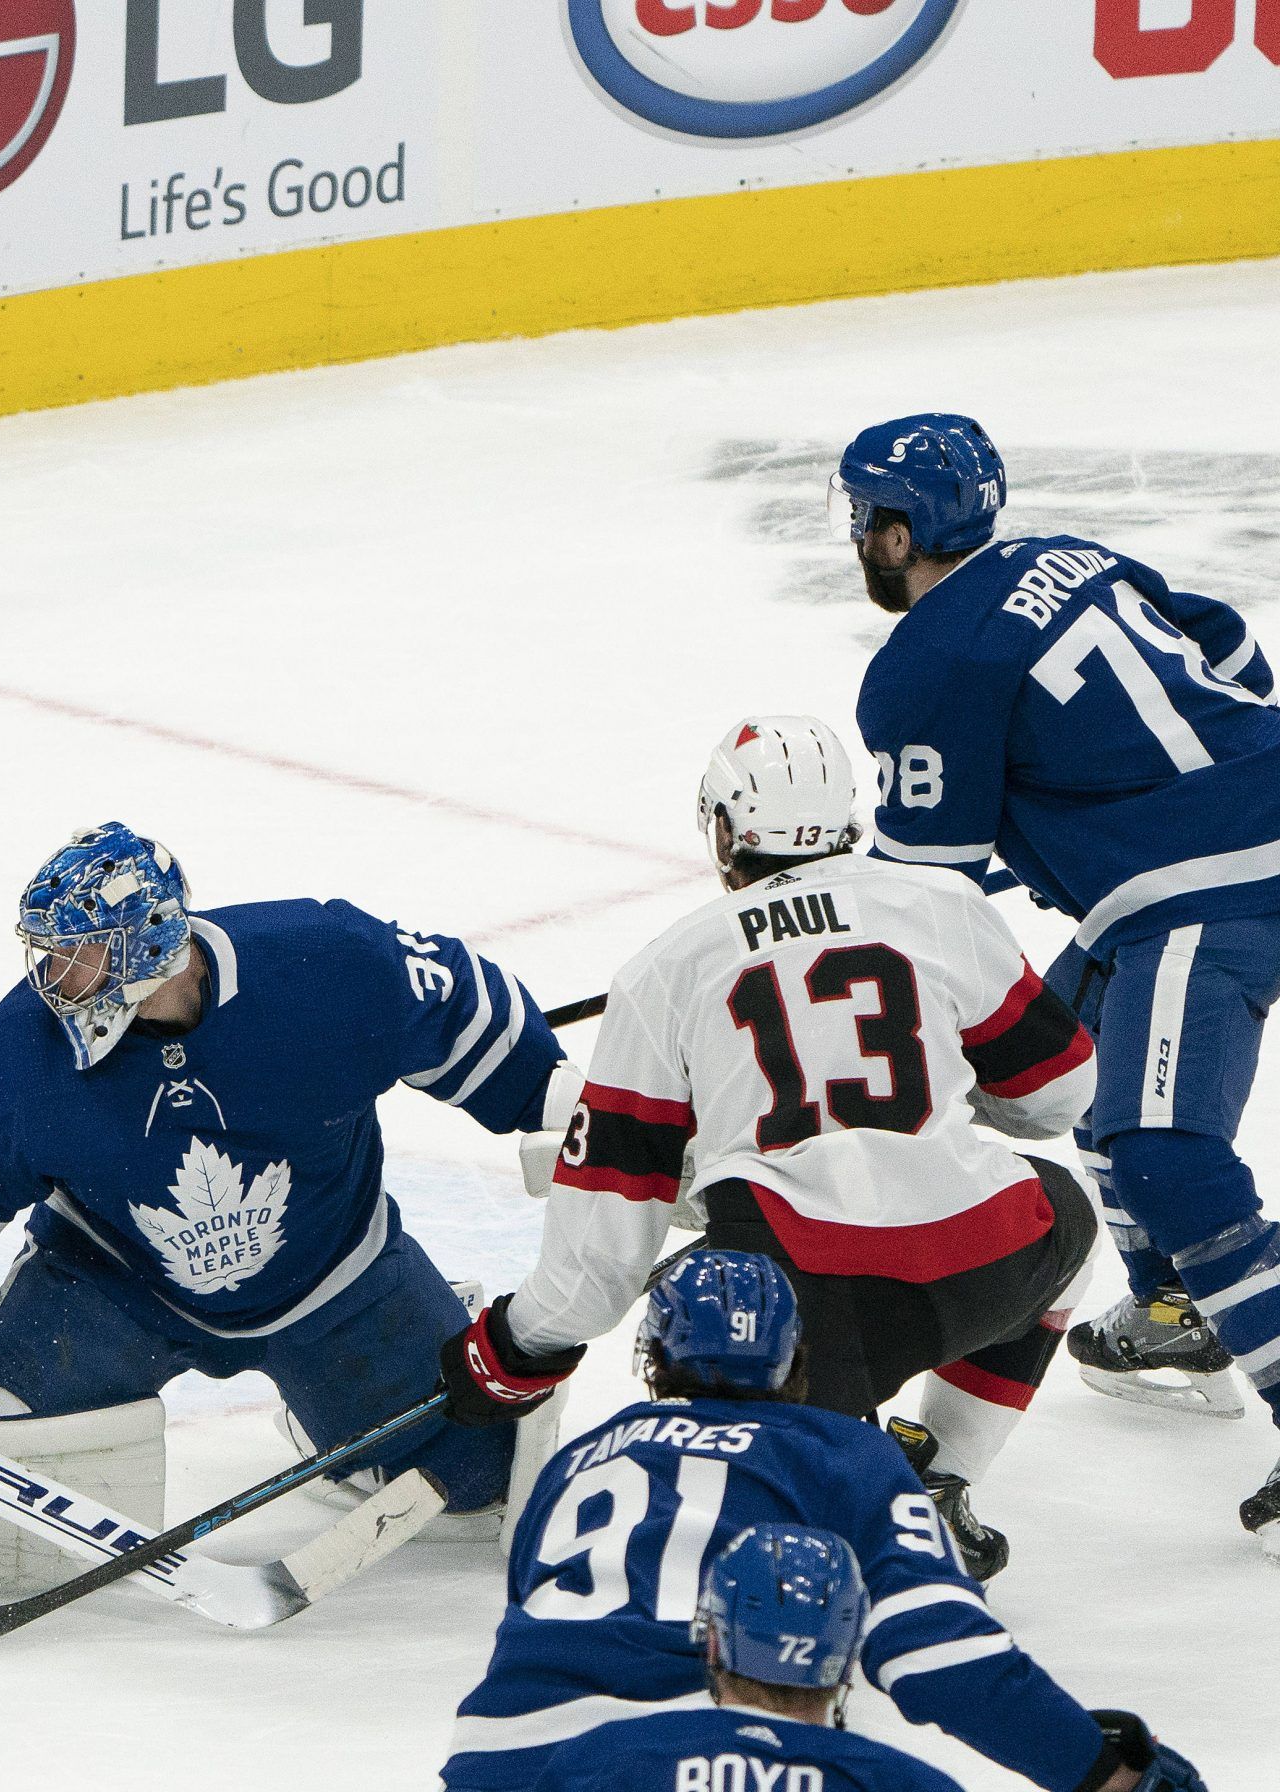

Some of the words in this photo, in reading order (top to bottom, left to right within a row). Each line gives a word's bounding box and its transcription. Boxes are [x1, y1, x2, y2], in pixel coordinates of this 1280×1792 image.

[121, 166, 247, 240] Life's
[268, 142, 406, 217] Good
[978, 479, 999, 509] 78
[793, 825, 822, 847] 13
[764, 876, 803, 891] adidas
[738, 892, 851, 952] PAUL
[726, 942, 934, 1154] 13
[1155, 1037, 1171, 1099] CCM
[164, 1206, 273, 1251] TORONTO
[186, 1226, 260, 1262] MAPLE
[189, 1242, 262, 1277] LEAFS
[731, 1310, 756, 1342] 91
[565, 1416, 761, 1480] TAVARES
[523, 1454, 729, 1623] 91
[779, 1633, 817, 1666] 72
[675, 1753, 824, 1792] BOYD
